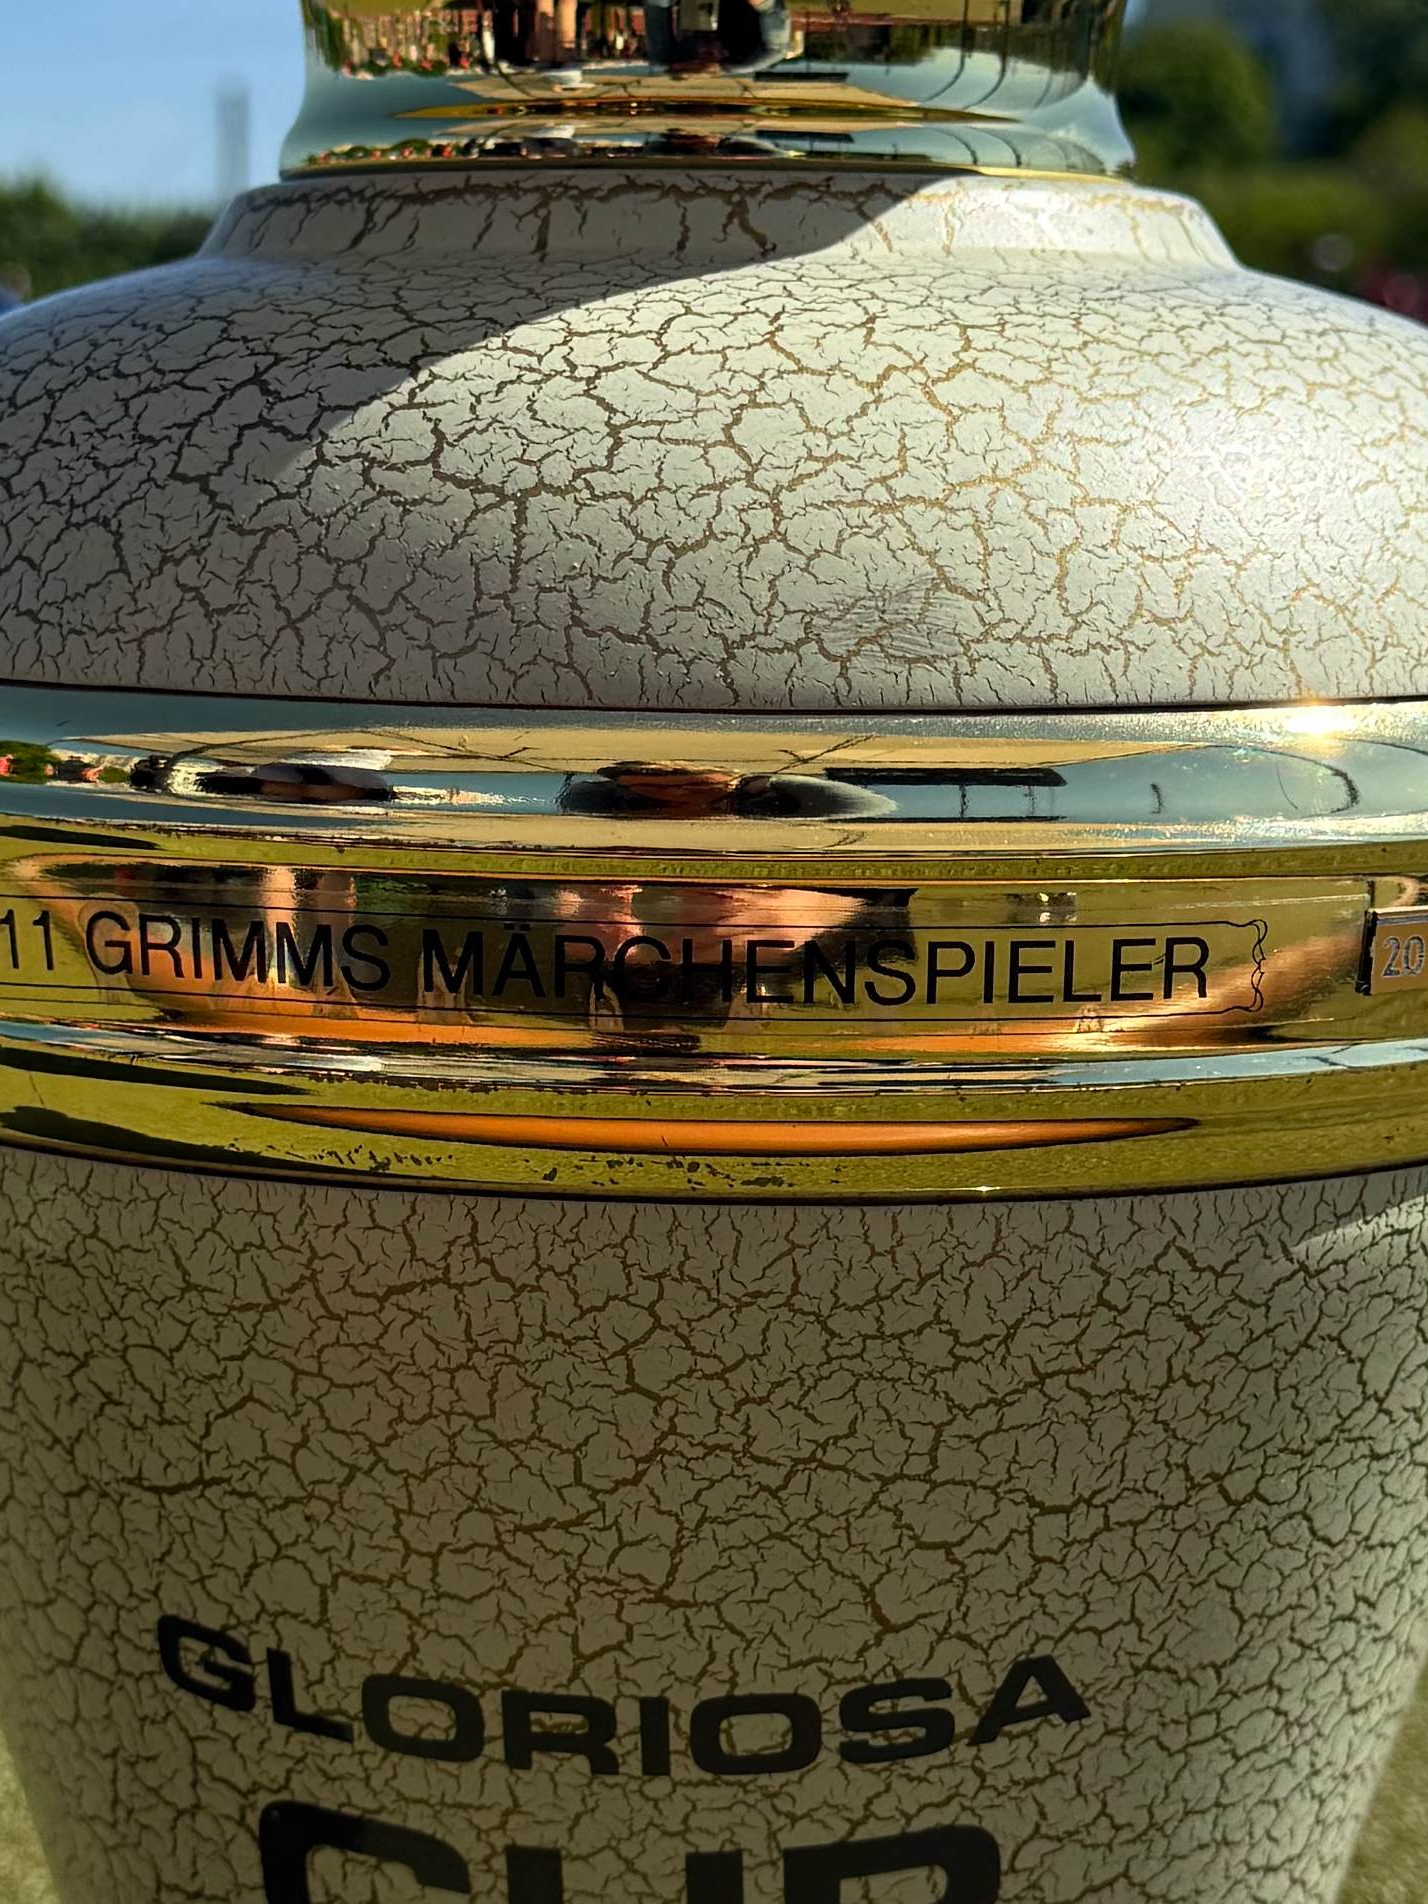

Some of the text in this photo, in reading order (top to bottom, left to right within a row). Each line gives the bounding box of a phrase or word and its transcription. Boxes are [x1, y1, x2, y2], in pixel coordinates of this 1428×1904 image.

[85, 909, 390, 992] GRIMMS
[421, 923, 1209, 1006] MÄRCHENSPIELER
[157, 1614, 1091, 1777] GLORIOSA
